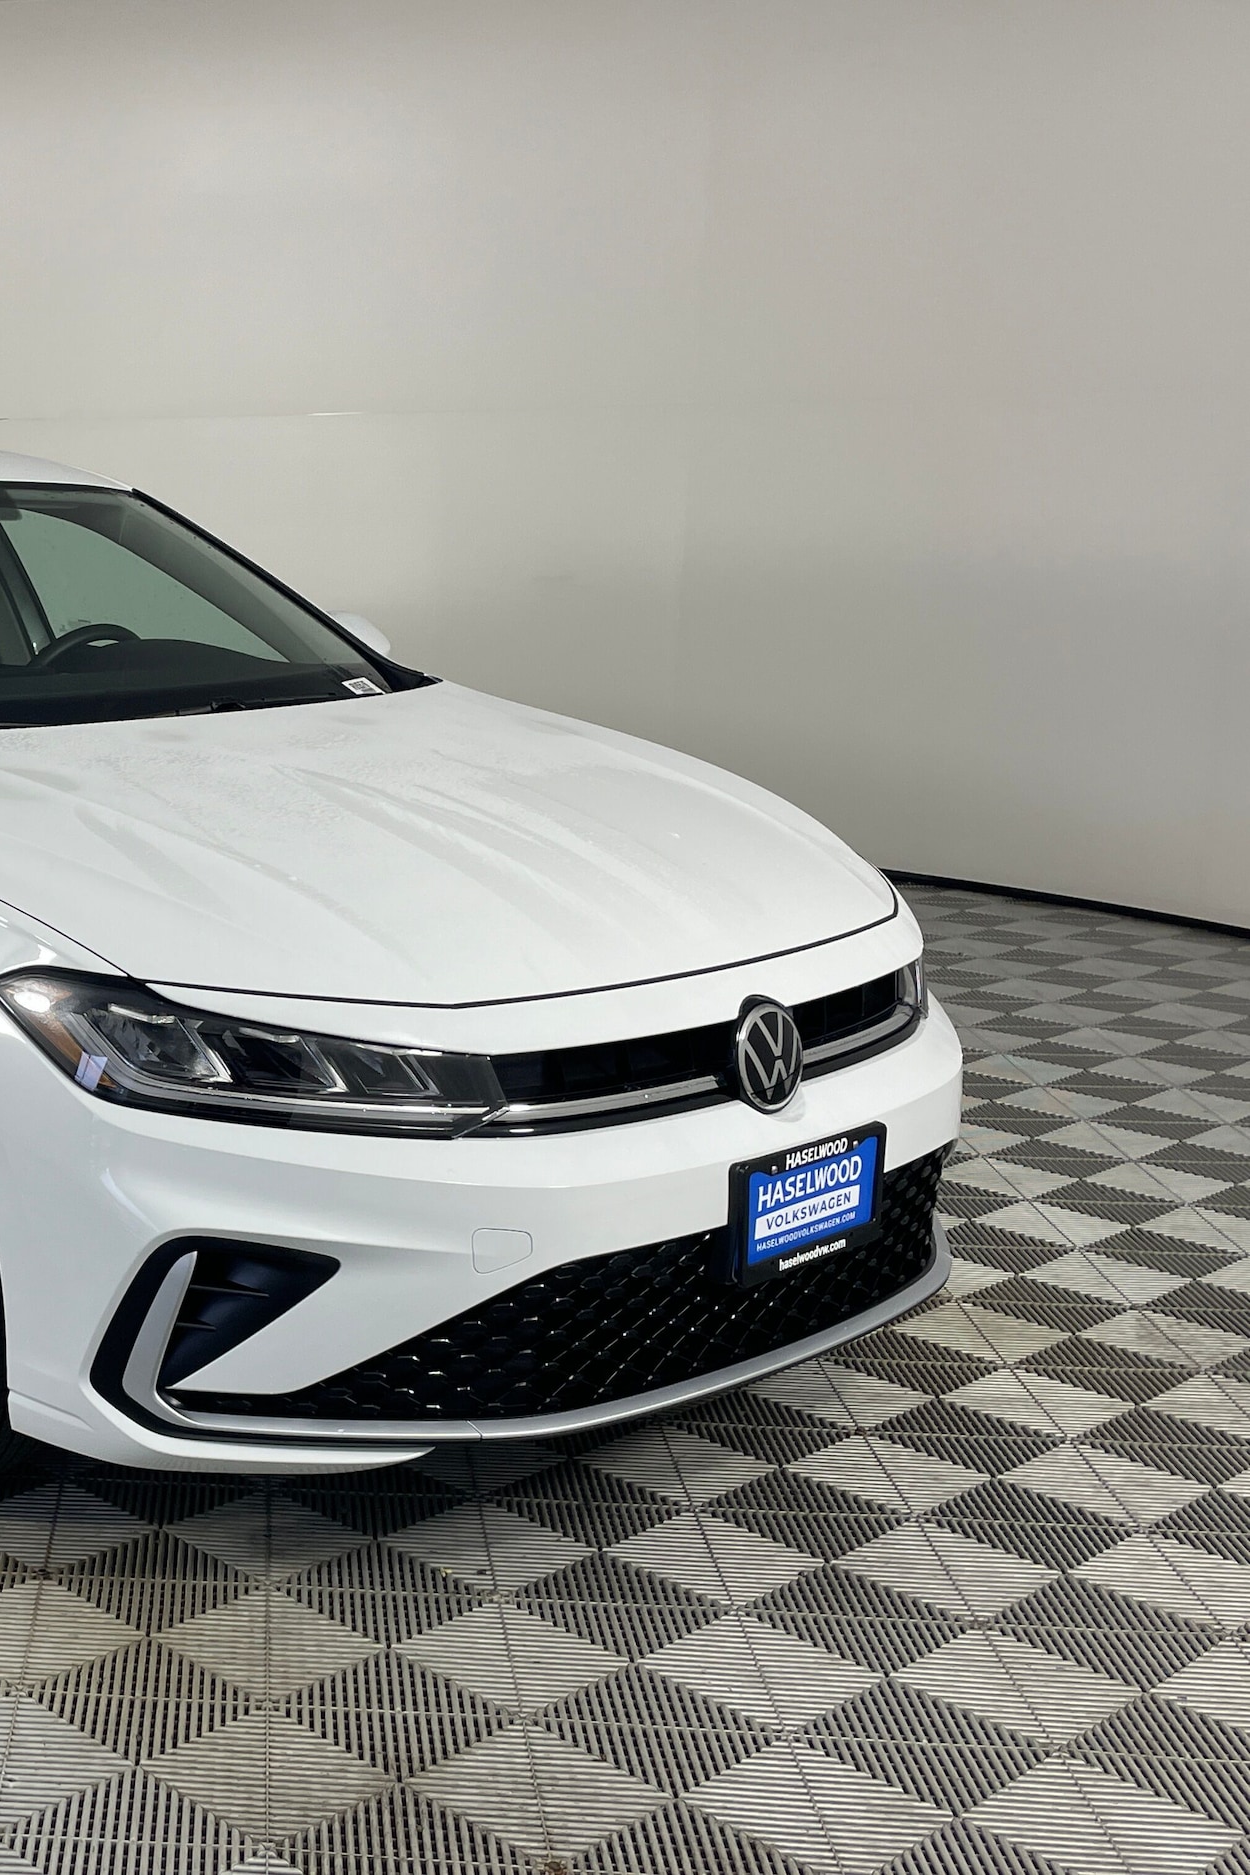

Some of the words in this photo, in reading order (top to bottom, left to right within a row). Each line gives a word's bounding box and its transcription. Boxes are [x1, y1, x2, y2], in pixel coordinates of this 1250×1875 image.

[785, 1137, 848, 1171] HASELWOOD
[757, 1155, 862, 1212] HASELWOOD
[766, 1190, 852, 1230] VOLKSWAGEN
[756, 1211, 856, 1252] HASELWOODVOLKSWAGEN.COM
[779, 1238, 846, 1271] haselwoodvw.com
